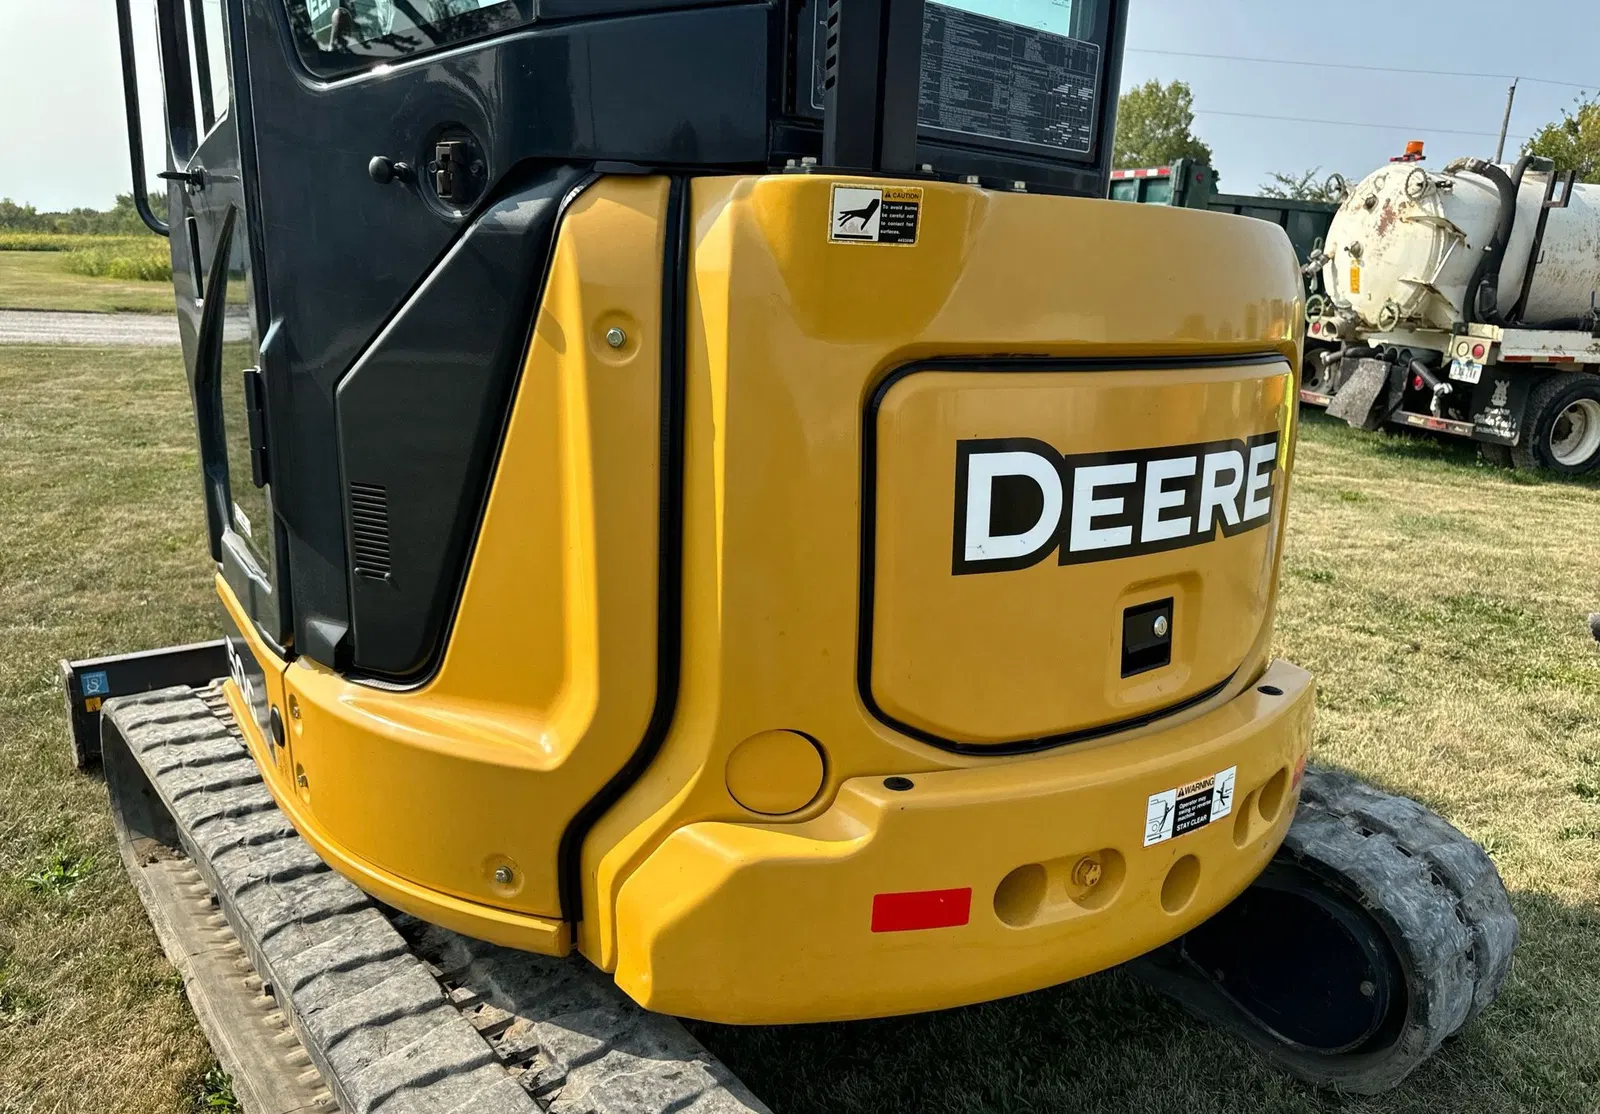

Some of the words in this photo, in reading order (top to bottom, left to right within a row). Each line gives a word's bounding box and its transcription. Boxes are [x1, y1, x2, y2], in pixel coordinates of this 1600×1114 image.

[892, 192, 919, 200] CAUTION
[963, 441, 1277, 562] DEERE
[1184, 776, 1215, 795] WARNING
[1178, 807, 1191, 816] swing
[1196, 799, 1212, 809] reverse
[1179, 798, 1198, 810] Operator
[1197, 795, 1207, 803] may
[1176, 822, 1190, 832] STAY
[1190, 814, 1208, 826] CLEAR
[1177, 811, 1196, 822] machine
